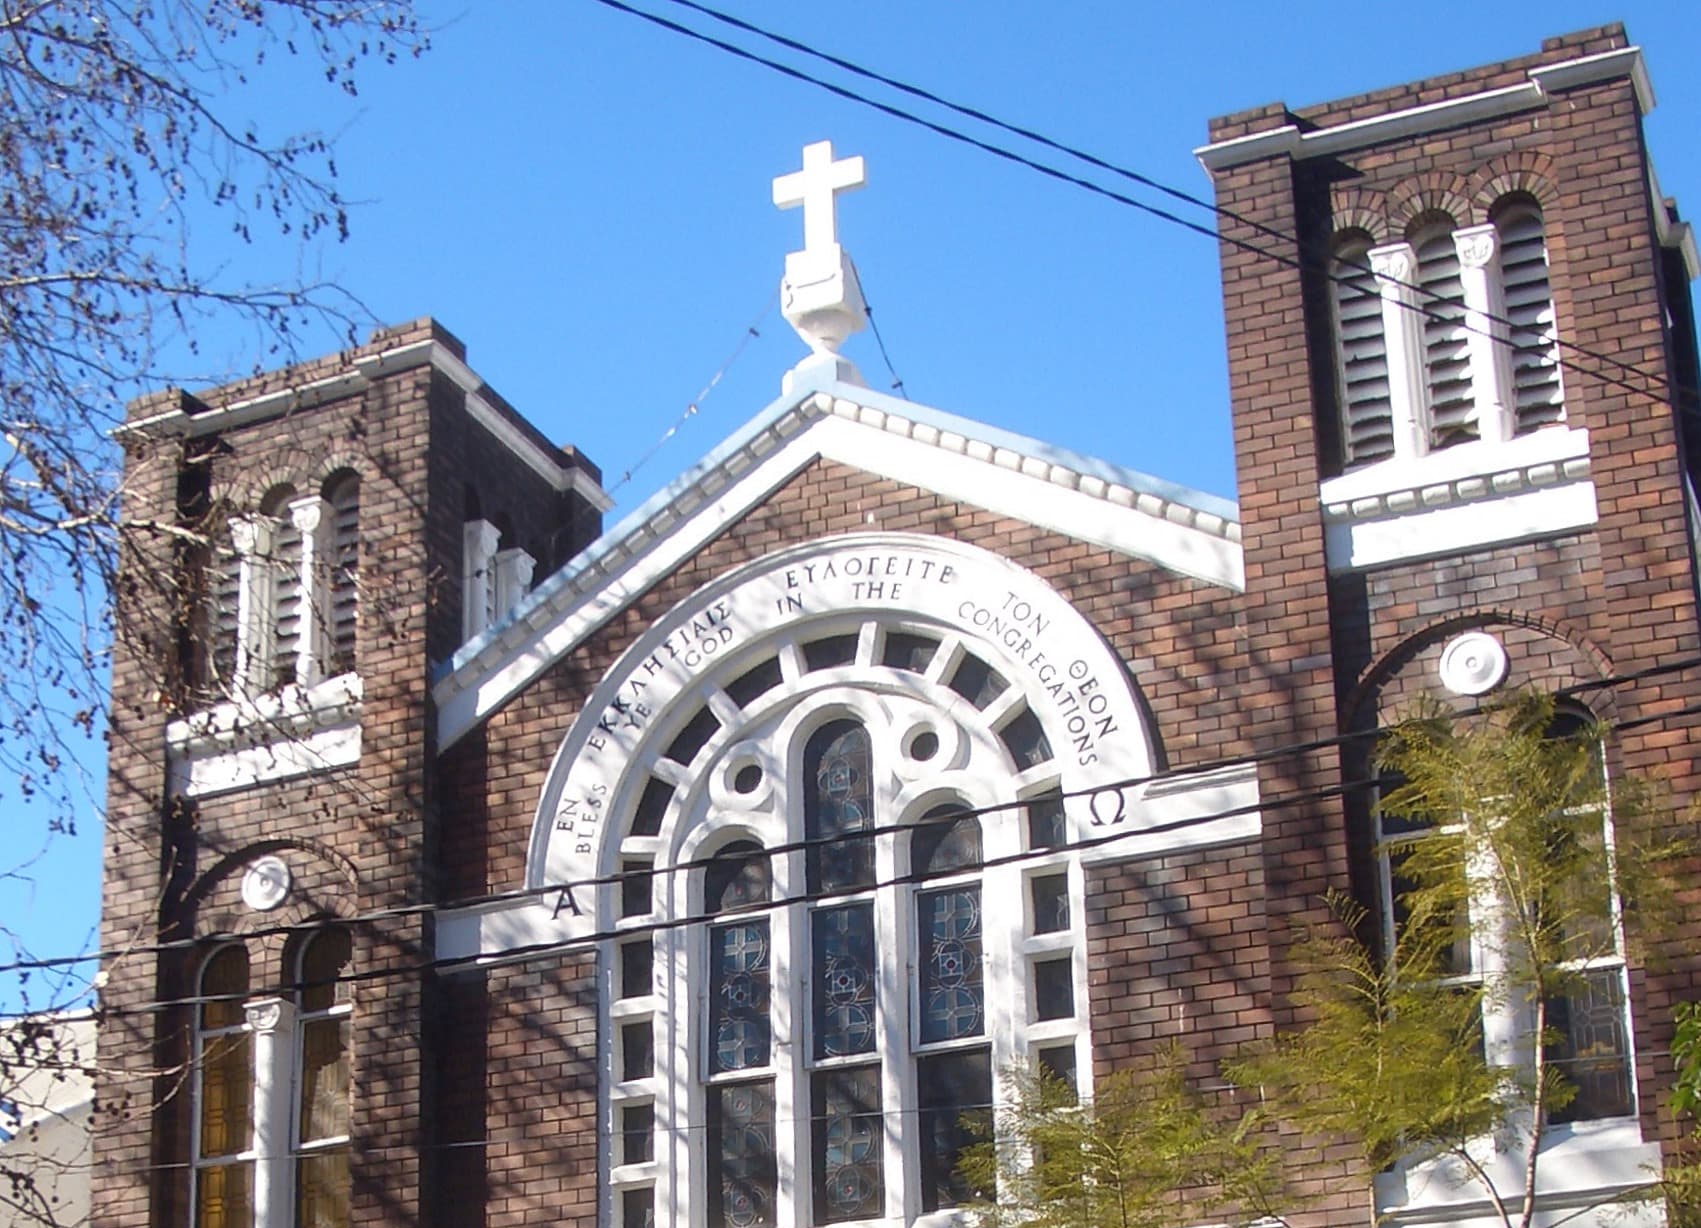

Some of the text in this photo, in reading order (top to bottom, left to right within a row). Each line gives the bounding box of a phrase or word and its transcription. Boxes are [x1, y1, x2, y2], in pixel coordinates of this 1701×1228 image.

[575, 580, 1099, 854] BLESS YE GOD IN THE CONGREGATIONS
[1068, 659, 1119, 739] ΘΕΟΝ
